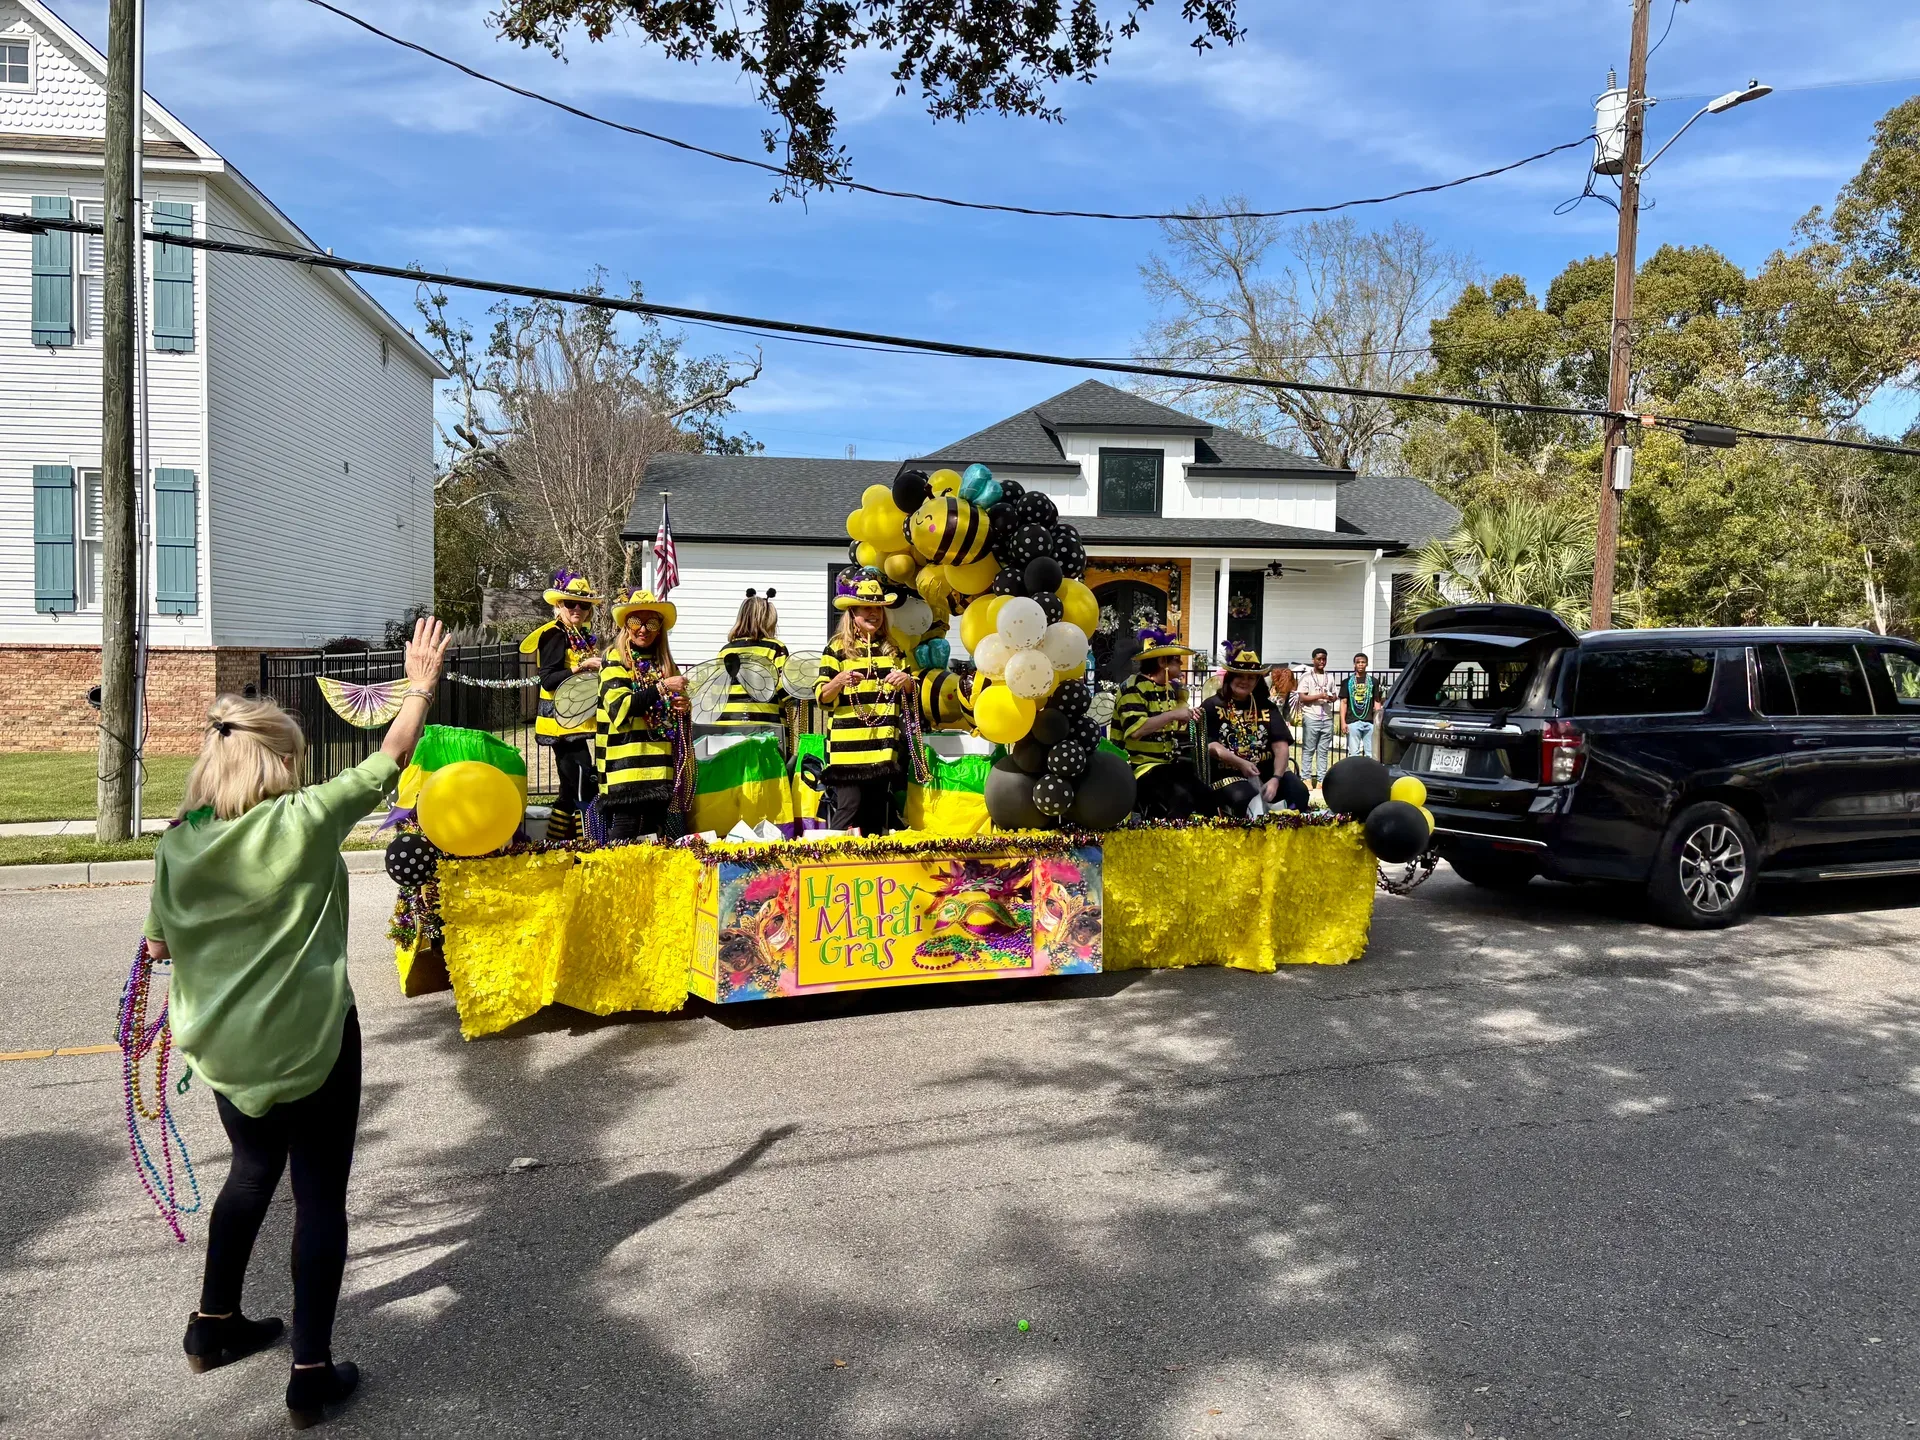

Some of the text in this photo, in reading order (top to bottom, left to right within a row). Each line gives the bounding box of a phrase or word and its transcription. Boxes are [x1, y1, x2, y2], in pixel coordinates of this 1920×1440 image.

[1413, 731, 1476, 741] SUBURBAN
[805, 874, 919, 918] Happy
[810, 901, 923, 943] Mardi
[819, 935, 896, 970] Gras
